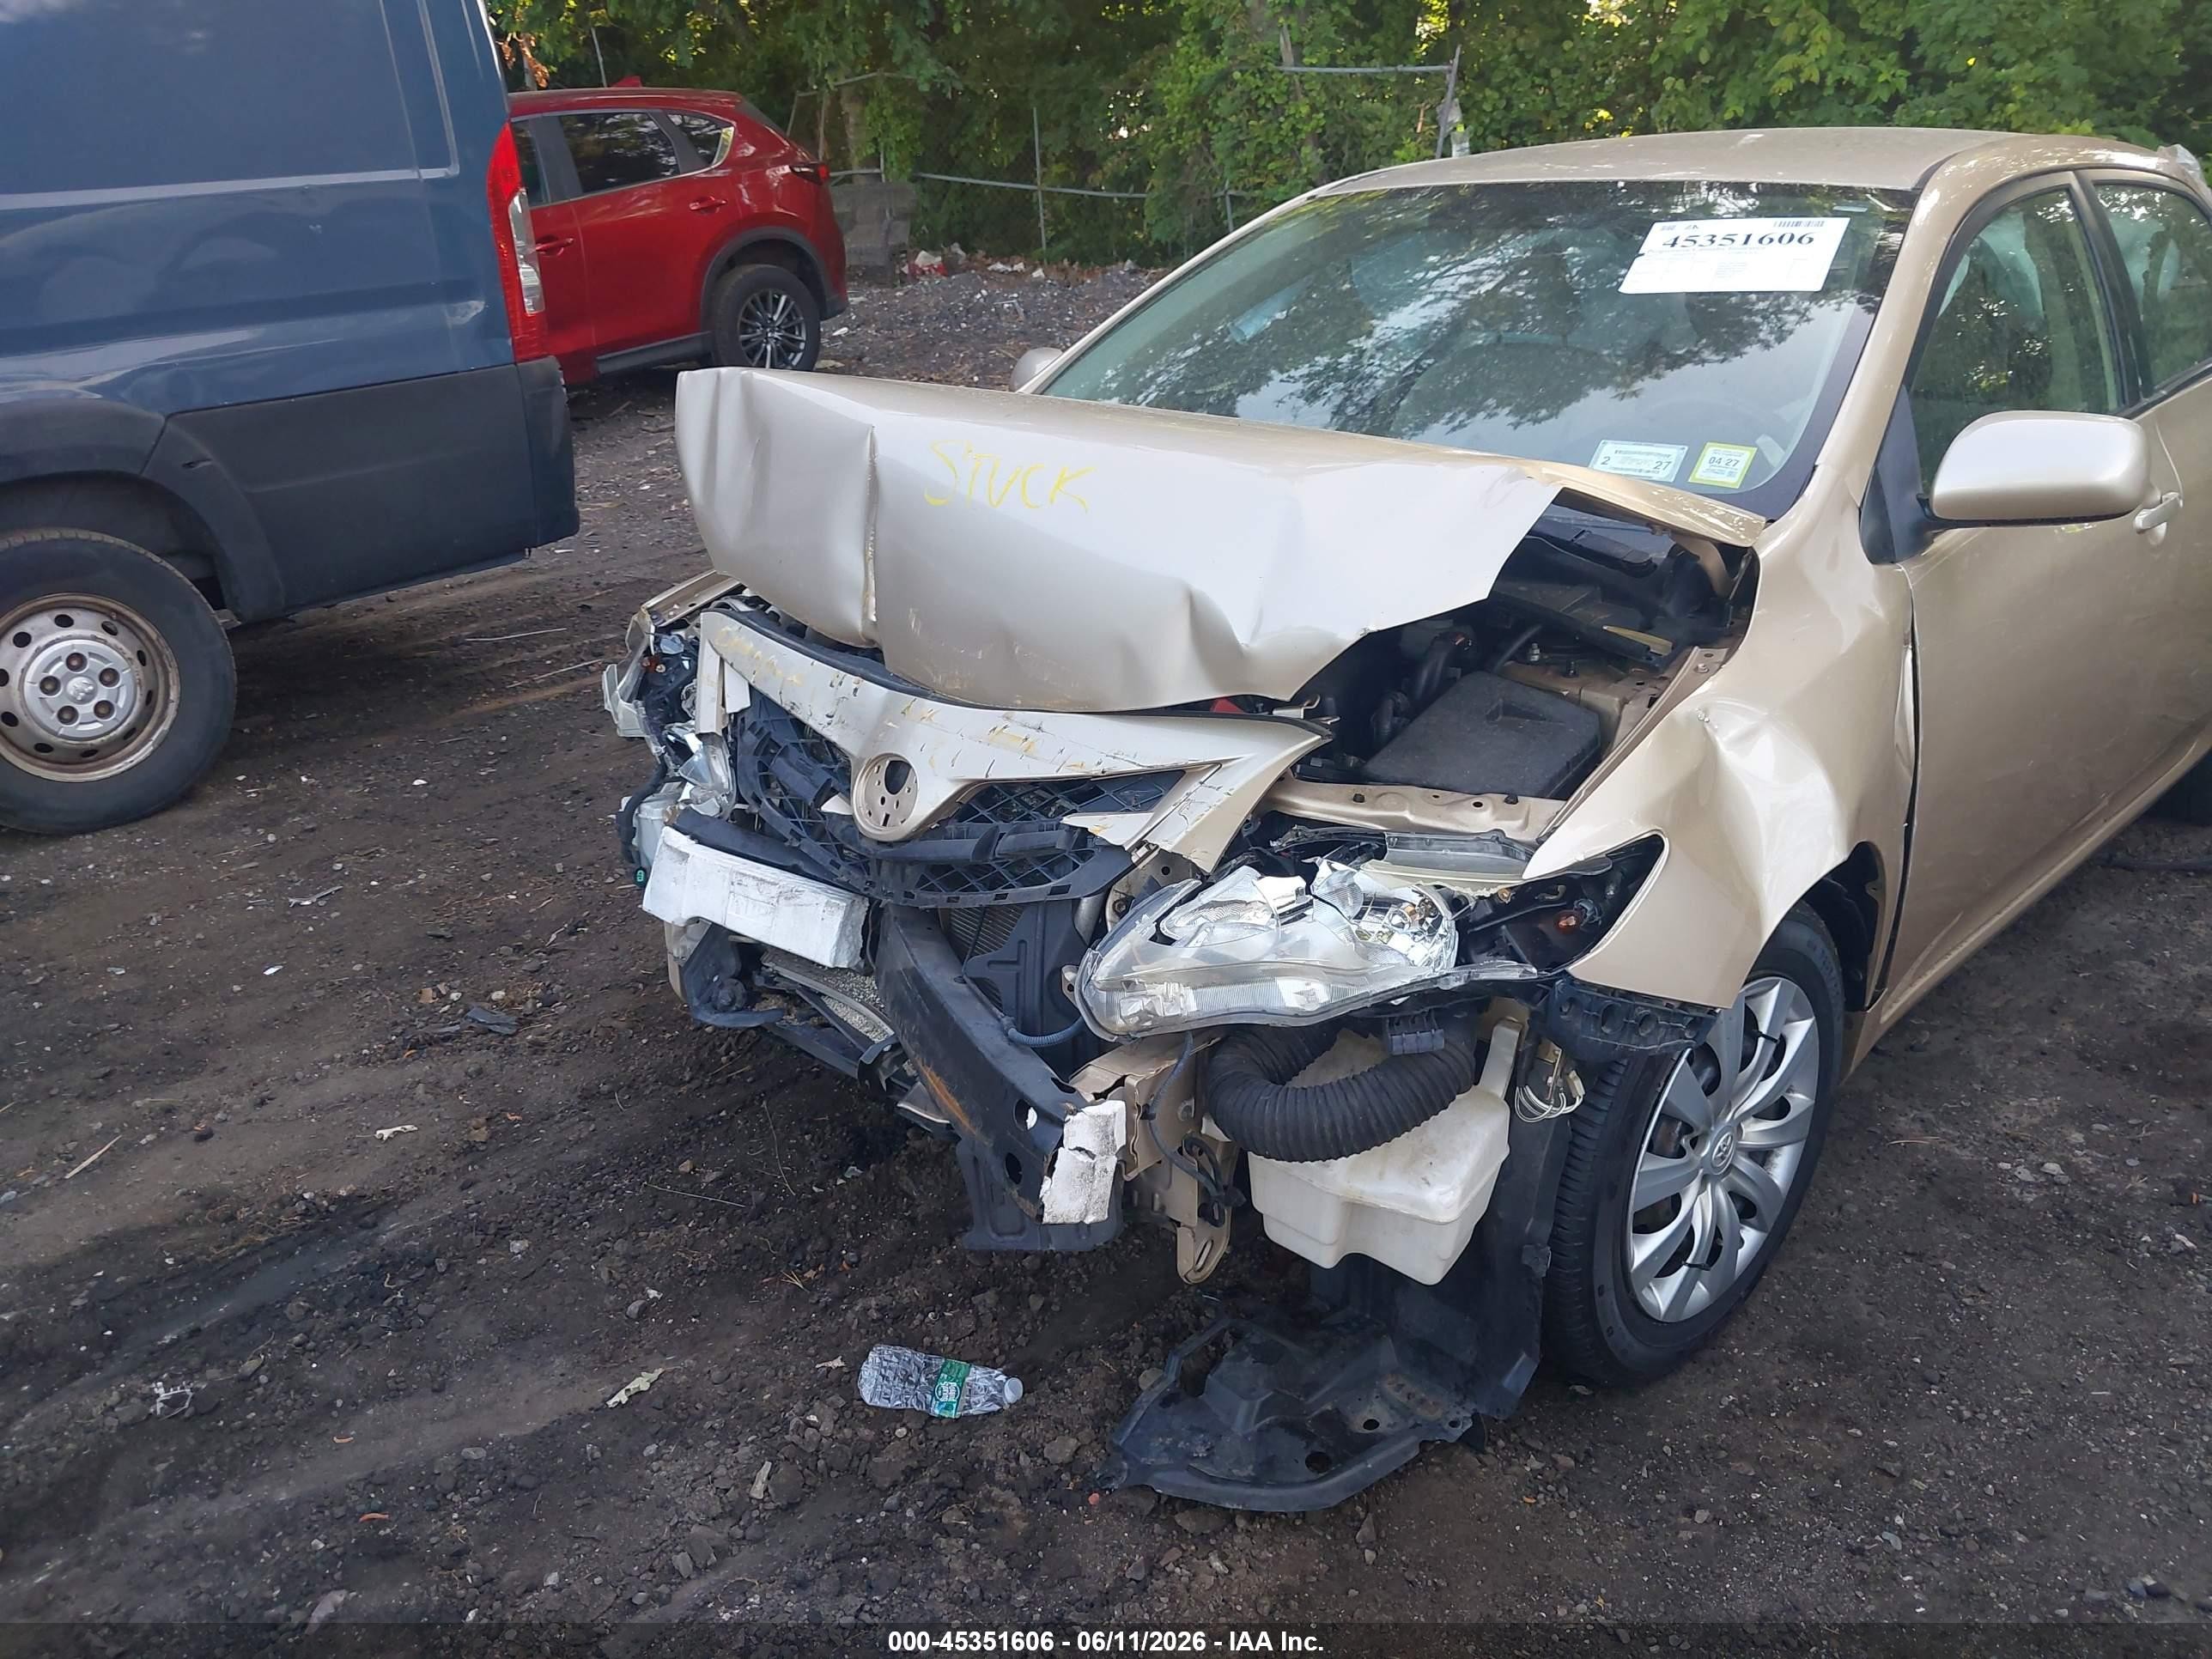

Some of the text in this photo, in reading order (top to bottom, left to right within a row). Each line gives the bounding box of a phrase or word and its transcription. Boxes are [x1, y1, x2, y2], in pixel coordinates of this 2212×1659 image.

[1662, 231, 1816, 248] 45351606
[1653, 460, 1673, 471] 27
[1708, 456, 1741, 467] 04 27
[923, 439, 1097, 514] STUCK
